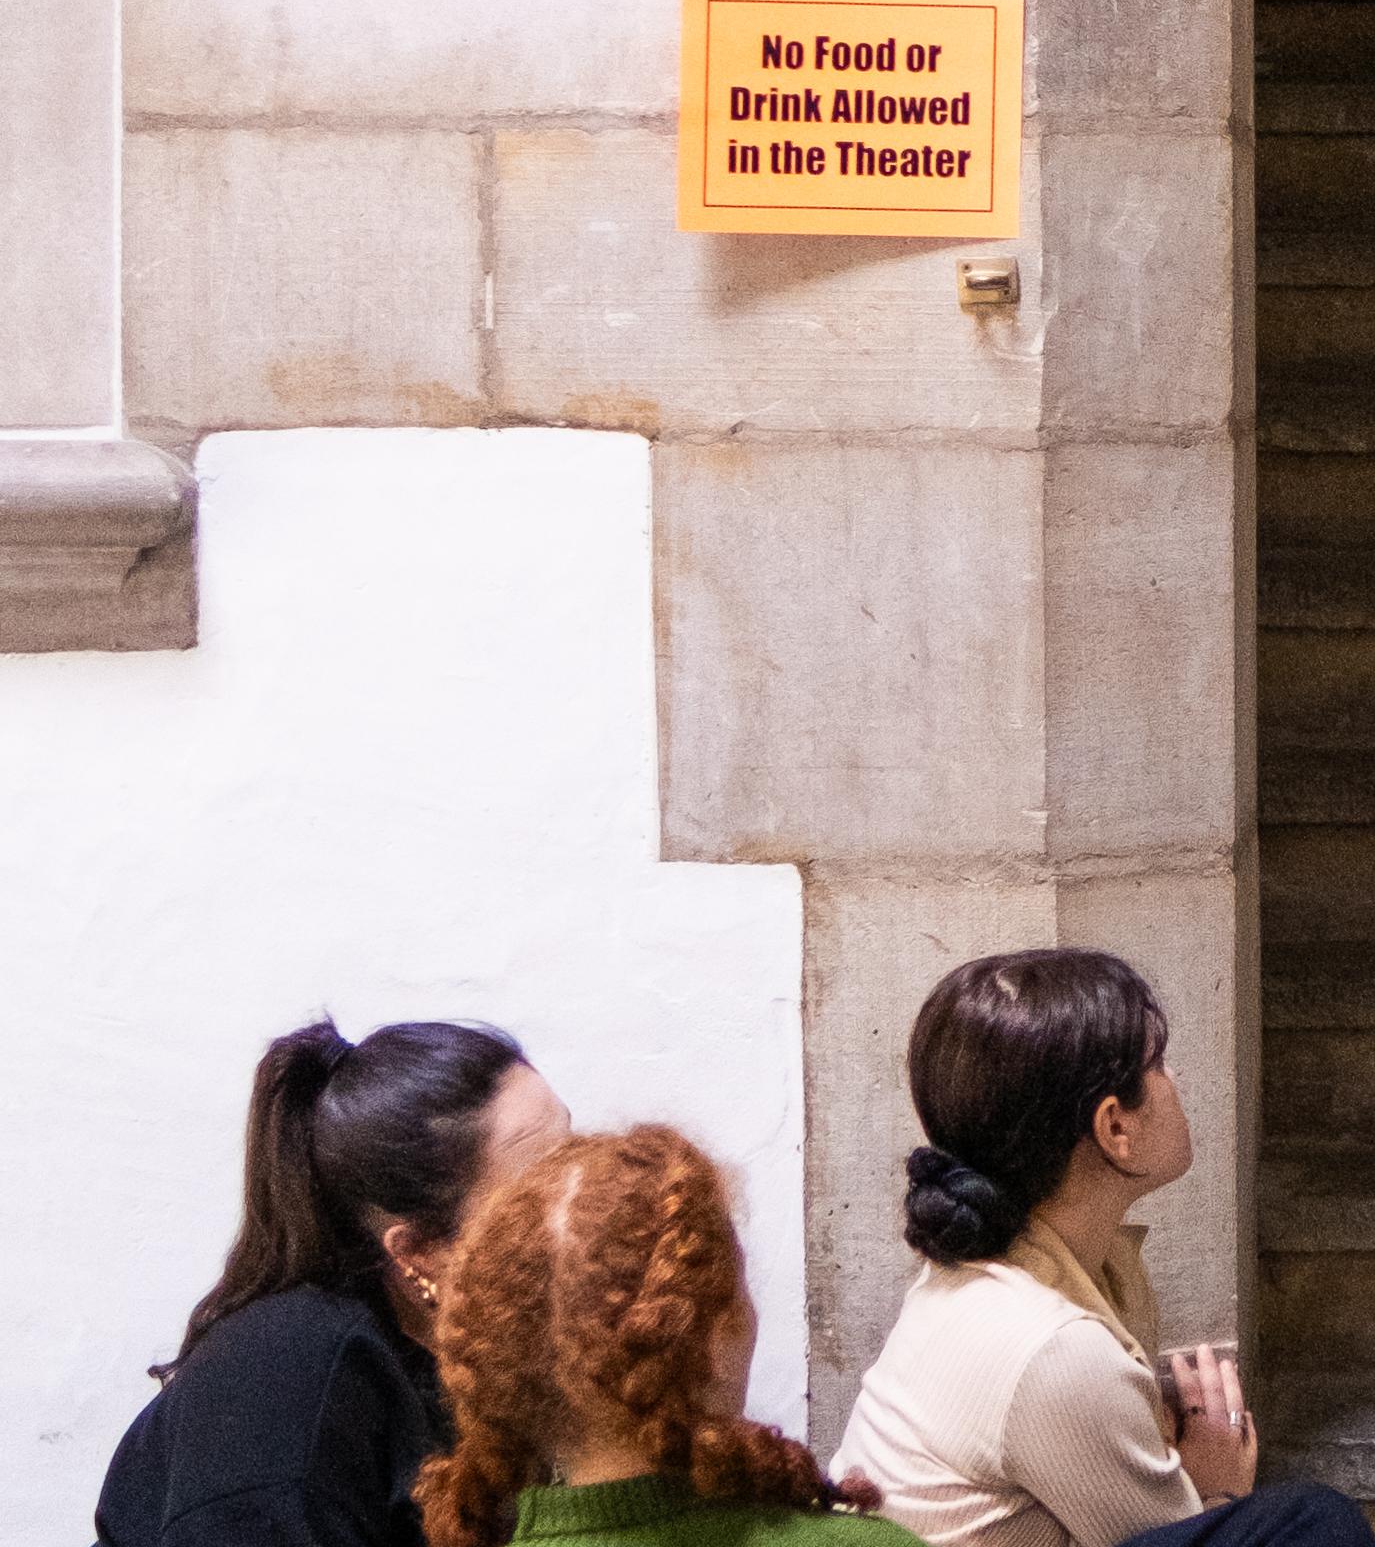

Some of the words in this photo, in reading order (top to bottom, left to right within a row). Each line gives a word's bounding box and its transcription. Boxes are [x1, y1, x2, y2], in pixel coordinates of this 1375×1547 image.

[761, 34, 804, 70] No
[814, 35, 896, 72] Food
[906, 43, 942, 73] or
[730, 86, 823, 123] Drink
[830, 89, 971, 126] Allowed
[728, 139, 760, 175] in
[769, 140, 826, 176] the
[834, 141, 972, 179] Theater
